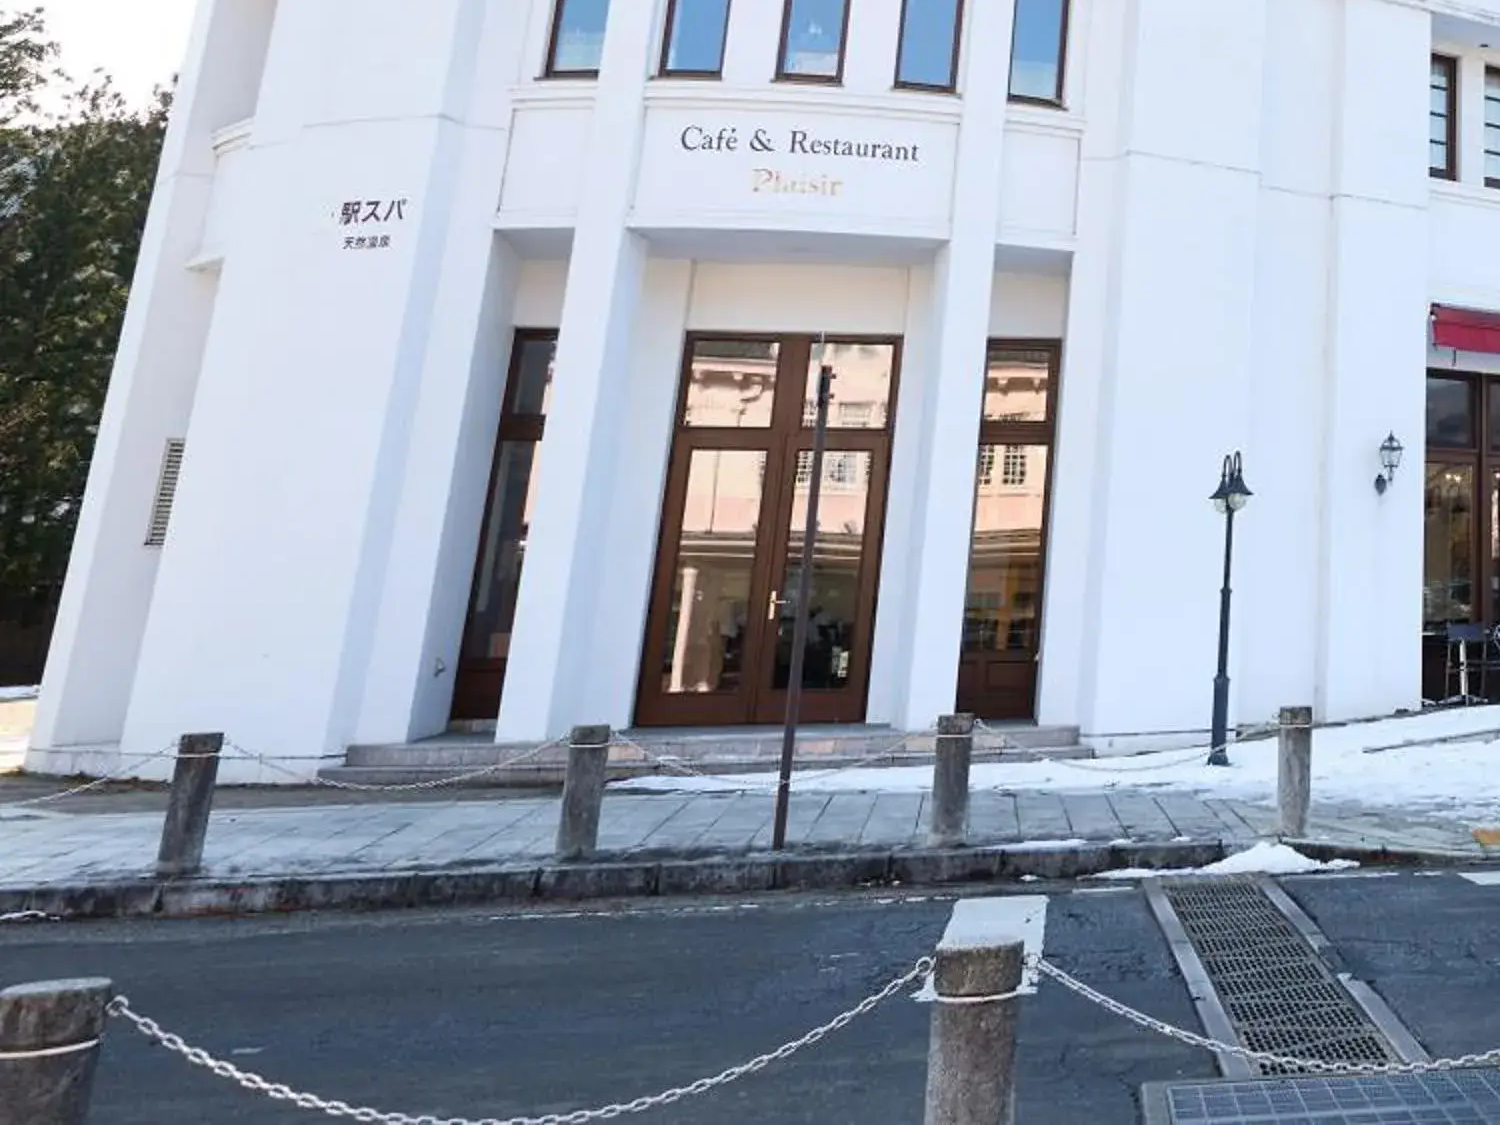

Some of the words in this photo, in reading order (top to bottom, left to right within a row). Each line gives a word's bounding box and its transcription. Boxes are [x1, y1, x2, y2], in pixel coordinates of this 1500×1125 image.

[680, 124, 738, 152] Café
[748, 128, 776, 152] &
[789, 129, 920, 162] Restaurant
[340, 198, 407, 225] 駅スパ
